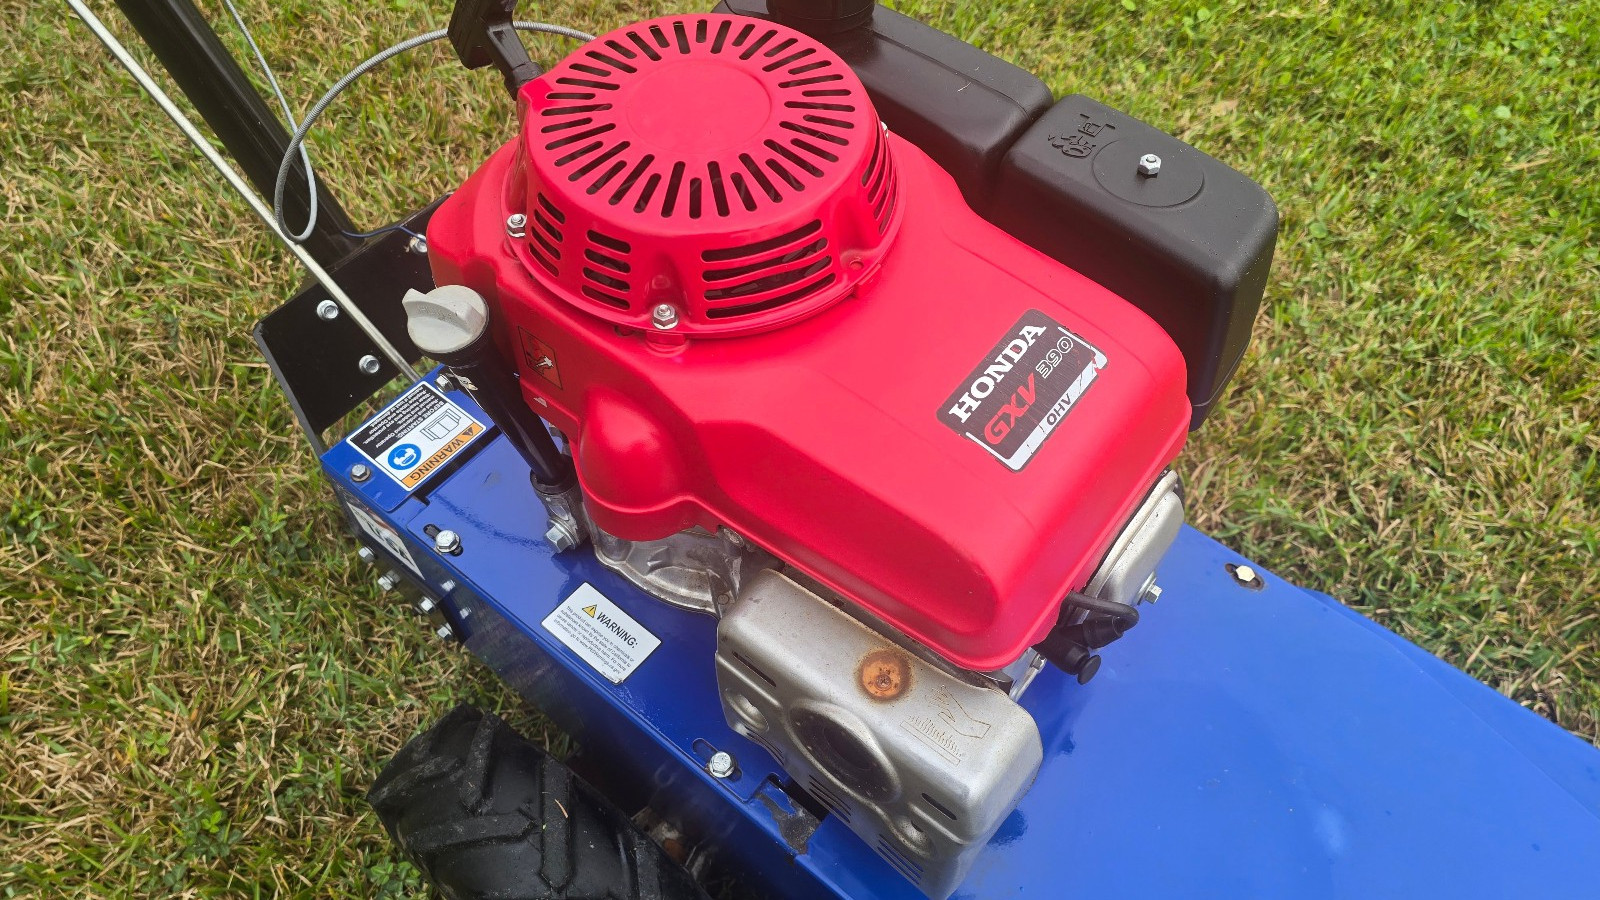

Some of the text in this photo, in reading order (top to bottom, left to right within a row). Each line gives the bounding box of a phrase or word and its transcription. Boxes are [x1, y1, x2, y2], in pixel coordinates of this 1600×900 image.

[949, 325, 1046, 423] HONDA
[984, 337, 1073, 444] GXV 390
[394, 400, 444, 439] BEFORE STARTING:
[1047, 393, 1072, 426] OHV
[410, 438, 464, 480] WARNING
